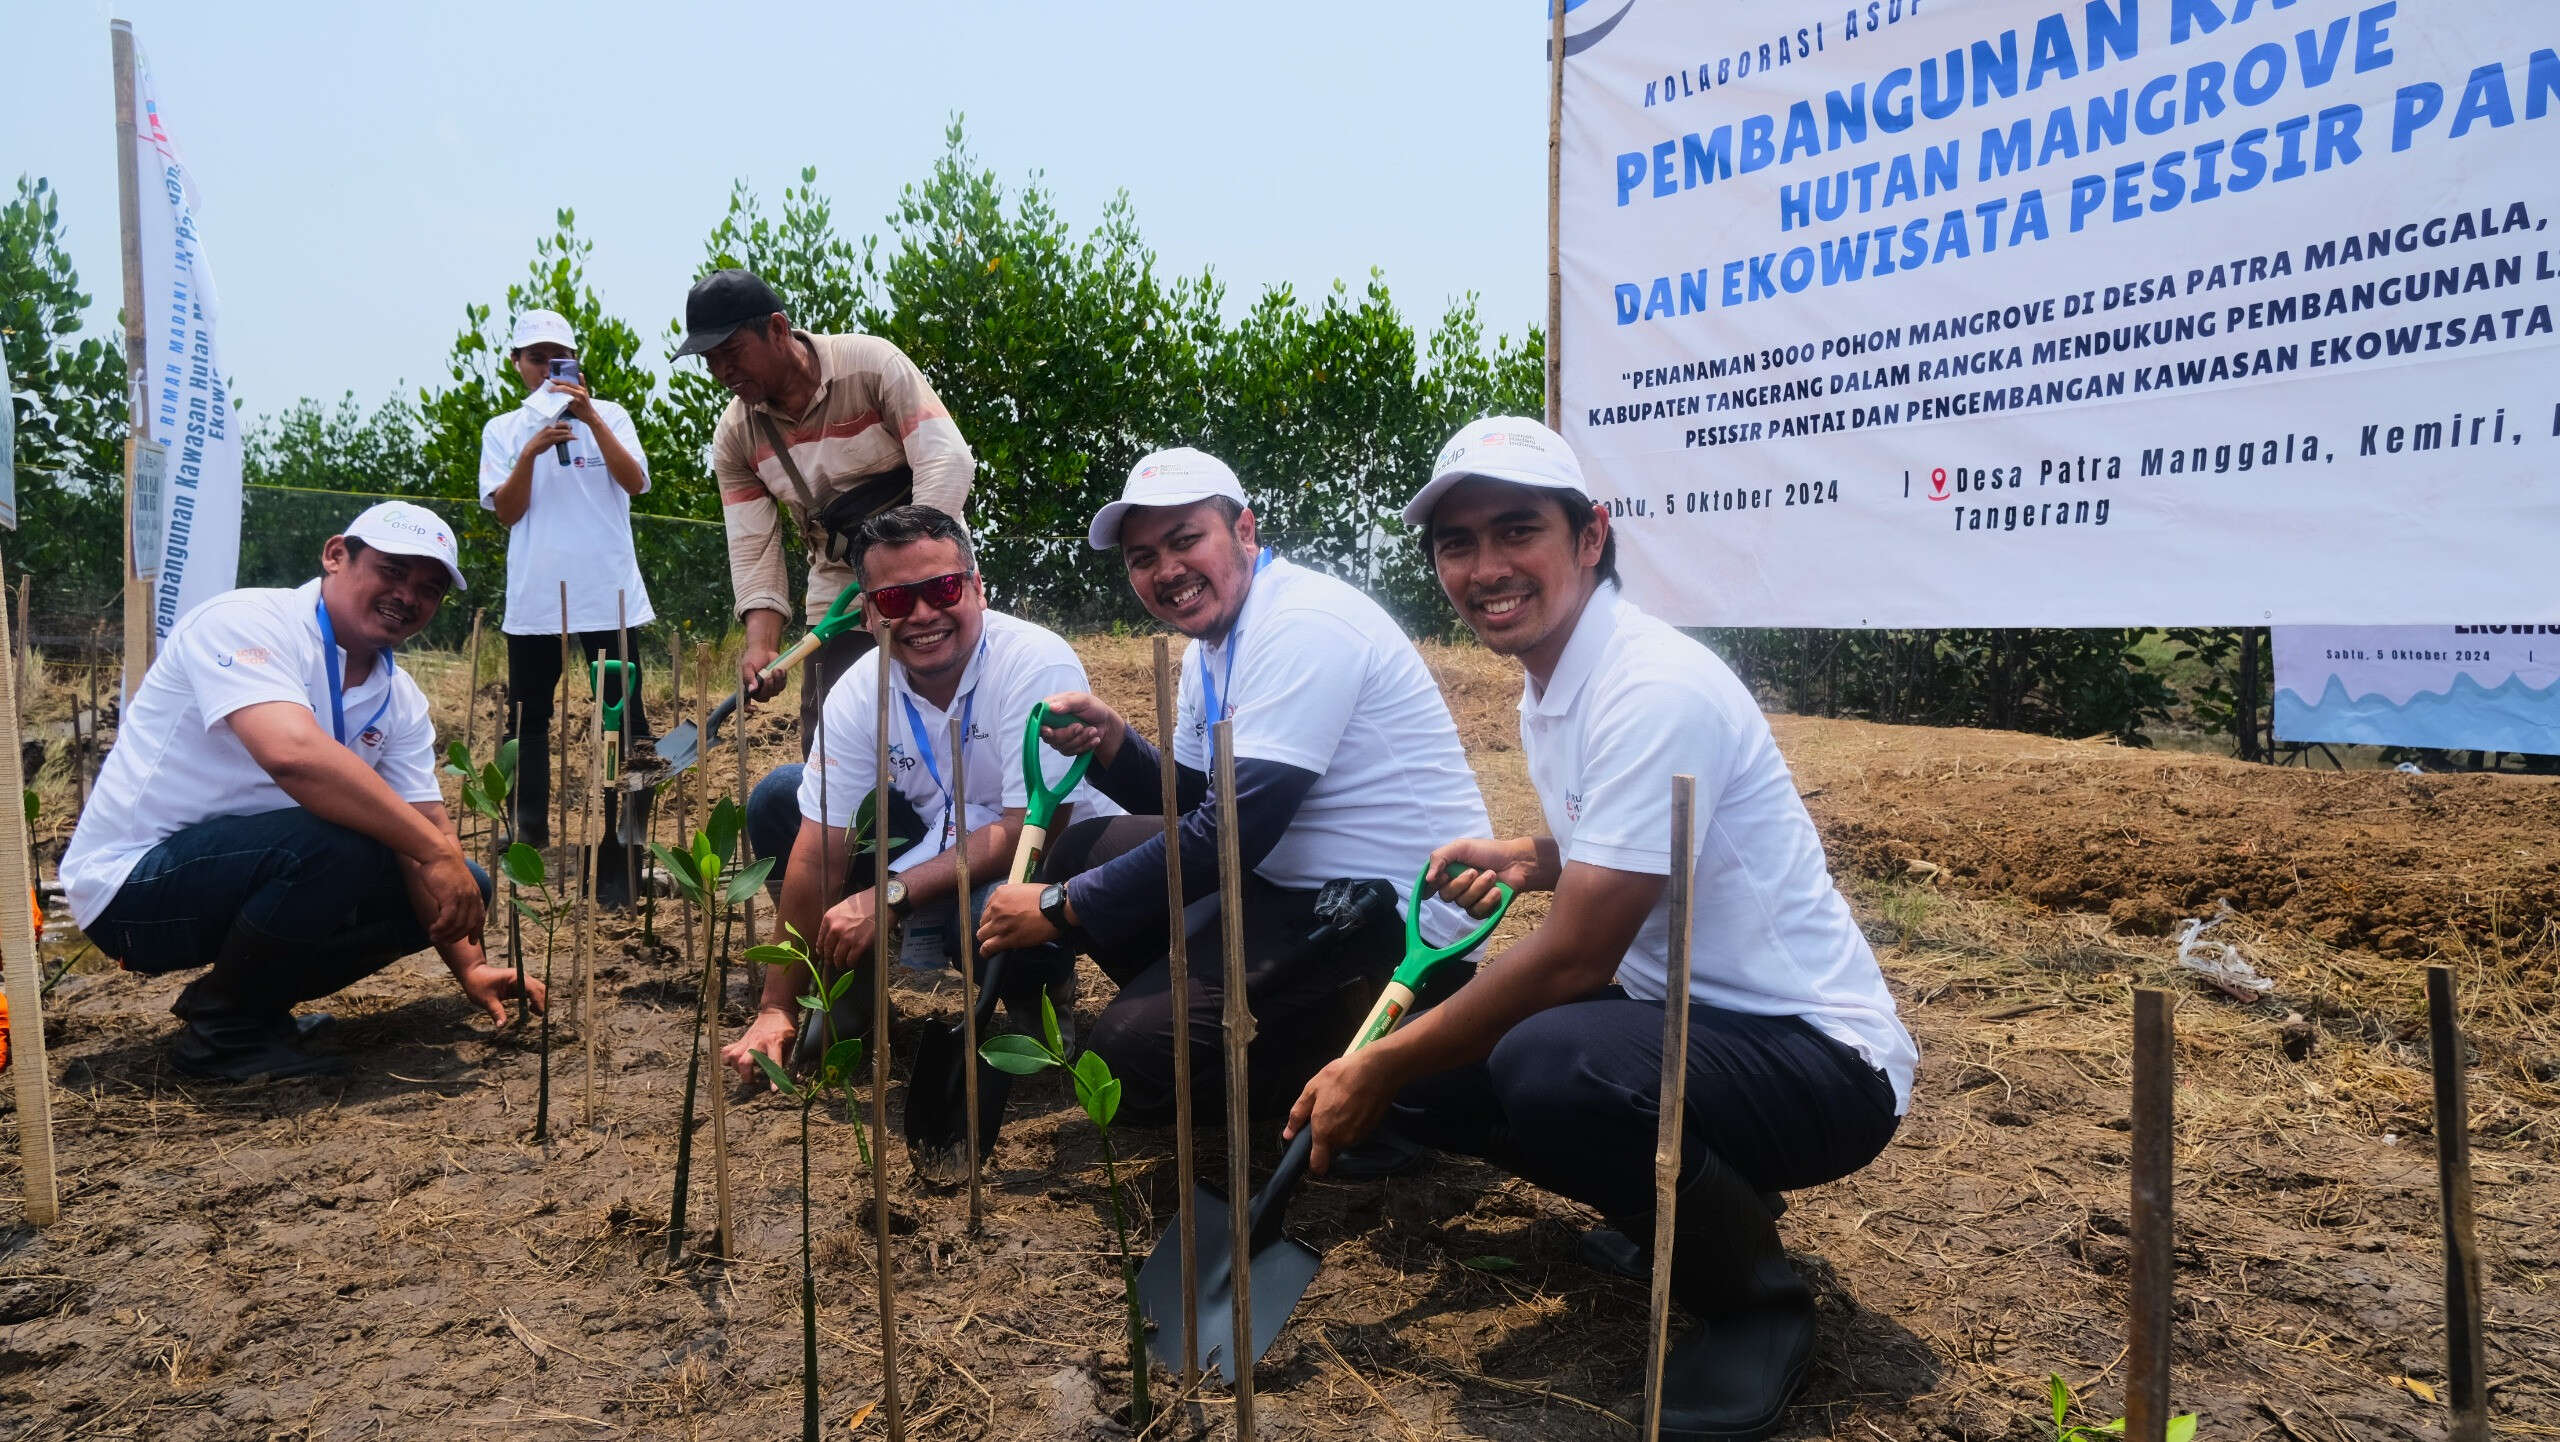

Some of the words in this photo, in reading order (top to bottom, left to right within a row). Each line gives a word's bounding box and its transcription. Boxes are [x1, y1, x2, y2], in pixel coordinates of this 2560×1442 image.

[1617, 0, 2138, 207] PEMBANGUNAN
[1645, 22, 1823, 107] KOLABORASI
[1780, 140, 1959, 232] HUTAN
[1979, 1, 2397, 182] MANGROVE
[1615, 268, 1707, 325] DAN
[1722, 189, 2049, 307] EKOWISATA
[2070, 104, 2363, 233] PESISIR
[169, 281, 188, 354] MADANI
[1761, 343, 1814, 370] 3000
[1822, 328, 1900, 360] POHON
[1909, 299, 2055, 345] MANGROVE
[2064, 291, 2095, 318] DI
[2104, 275, 2176, 311] DESA
[2187, 251, 2292, 295] PATRA
[2304, 202, 2547, 272] MANGGALA,
[190, 328, 209, 390] Hutan
[1589, 396, 1699, 426] KABUPATEN
[1706, 377, 1823, 412] TANGERANG
[1830, 364, 1910, 394] DALAM
[1918, 346, 2022, 382] RANGKA
[2032, 312, 2216, 365] MENDUKUNG
[2227, 256, 2521, 333] PEMBANGUNAN
[1686, 423, 1762, 448] PESISIR
[1768, 410, 1845, 439] PANTAI
[1852, 404, 1899, 429] DAN
[1907, 371, 2124, 422] PENGEMBANGAN
[2134, 344, 2298, 392] KAWASAN
[2310, 305, 2553, 367] EKOWISATA
[160, 364, 182, 426] RUMAH
[175, 396, 208, 489] Kawasan
[1957, 466, 2021, 492] Desa
[2040, 456, 2121, 485] Patra
[2141, 434, 2334, 476] Manggala,
[2360, 408, 2522, 456] Kemiri,
[1667, 494, 1675, 514] 5
[1687, 488, 1772, 513] Oktober
[1785, 480, 1839, 506] 2024
[1955, 499, 2110, 531] Tangerang
[156, 495, 196, 638] Pembangunan
[2377, 649, 2384, 660] 5
[2391, 649, 2448, 661] Oktober
[2455, 650, 2490, 662] 2024
